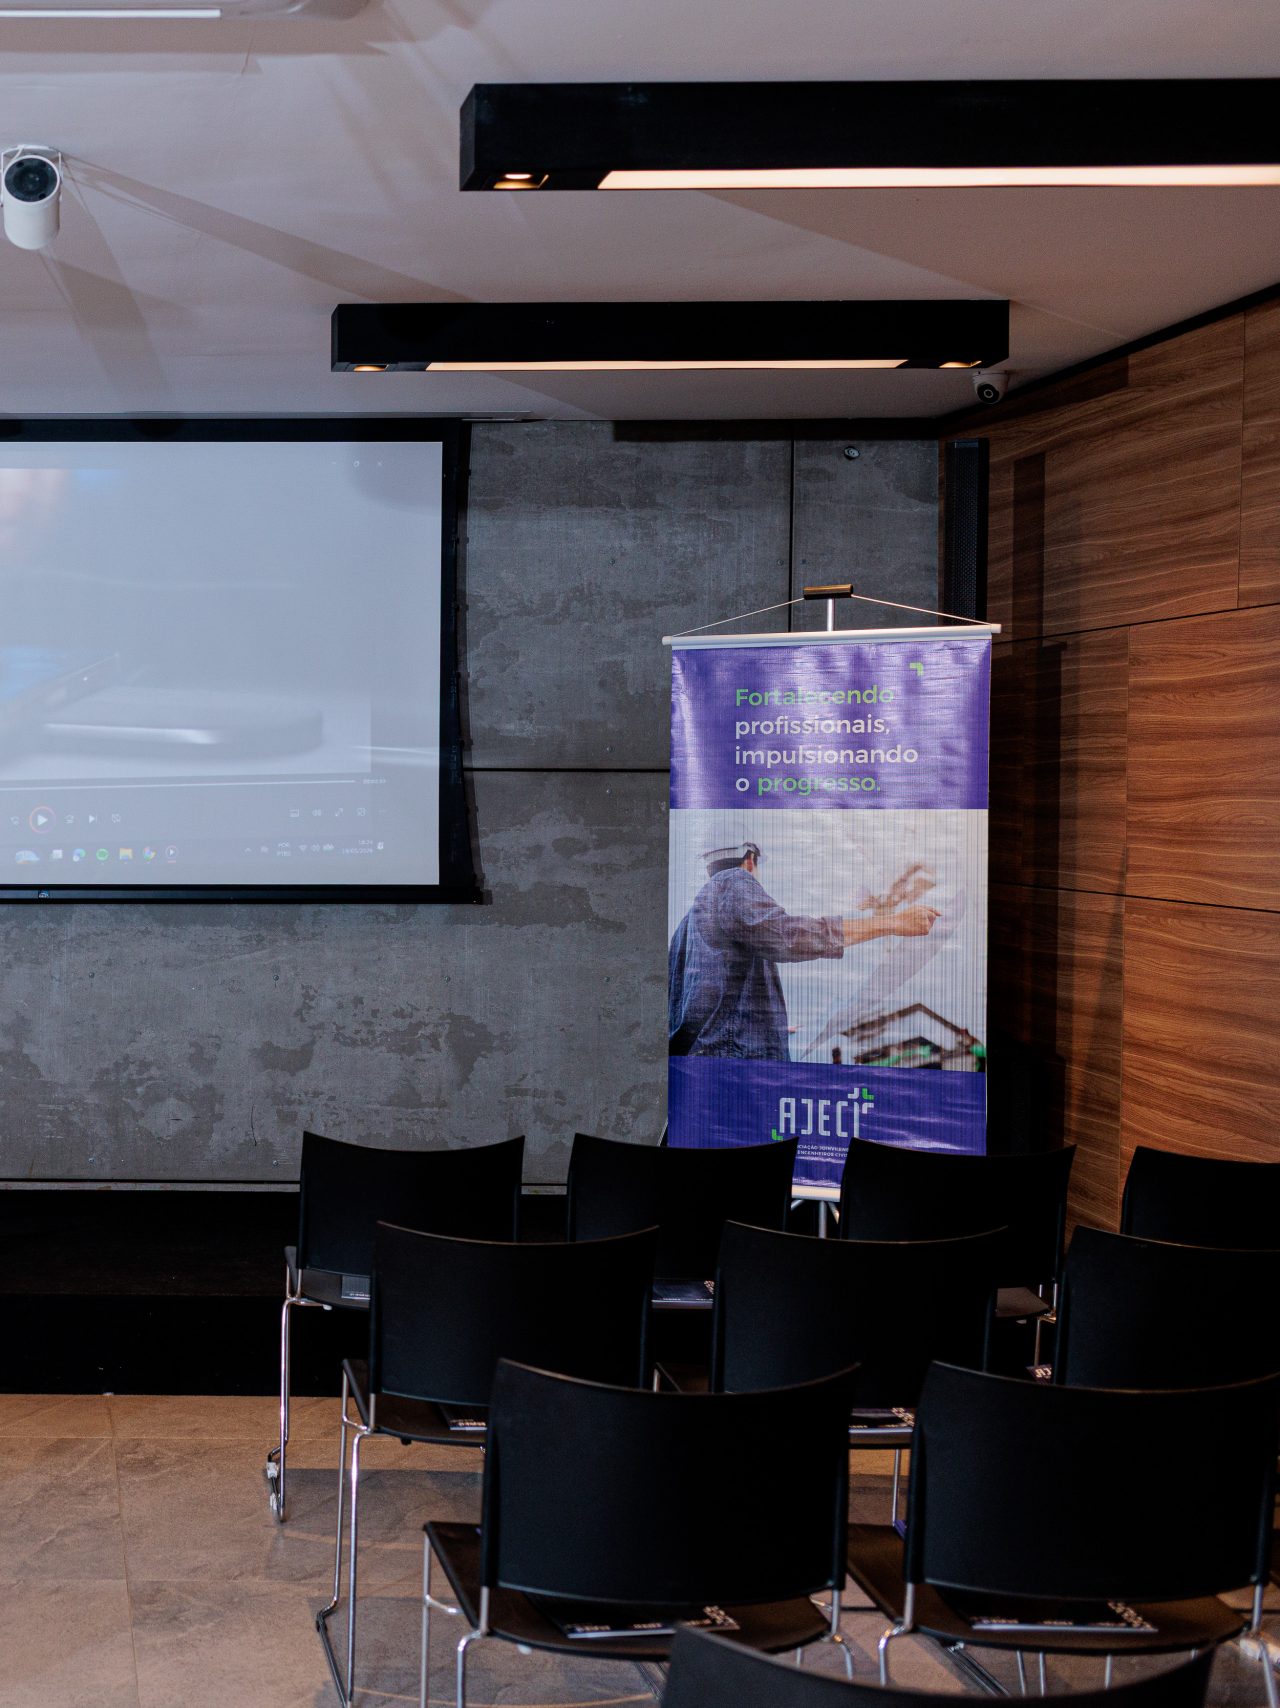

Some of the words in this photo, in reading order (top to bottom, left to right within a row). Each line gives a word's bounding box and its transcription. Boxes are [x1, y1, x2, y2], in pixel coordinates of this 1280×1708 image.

[735, 684, 894, 707] Fortalecendo
[735, 714, 890, 739] profissionais,
[735, 744, 919, 768] impulsionando
[735, 778, 750, 792] o
[757, 775, 881, 796] progresso.
[779, 1097, 860, 1139] AJECI
